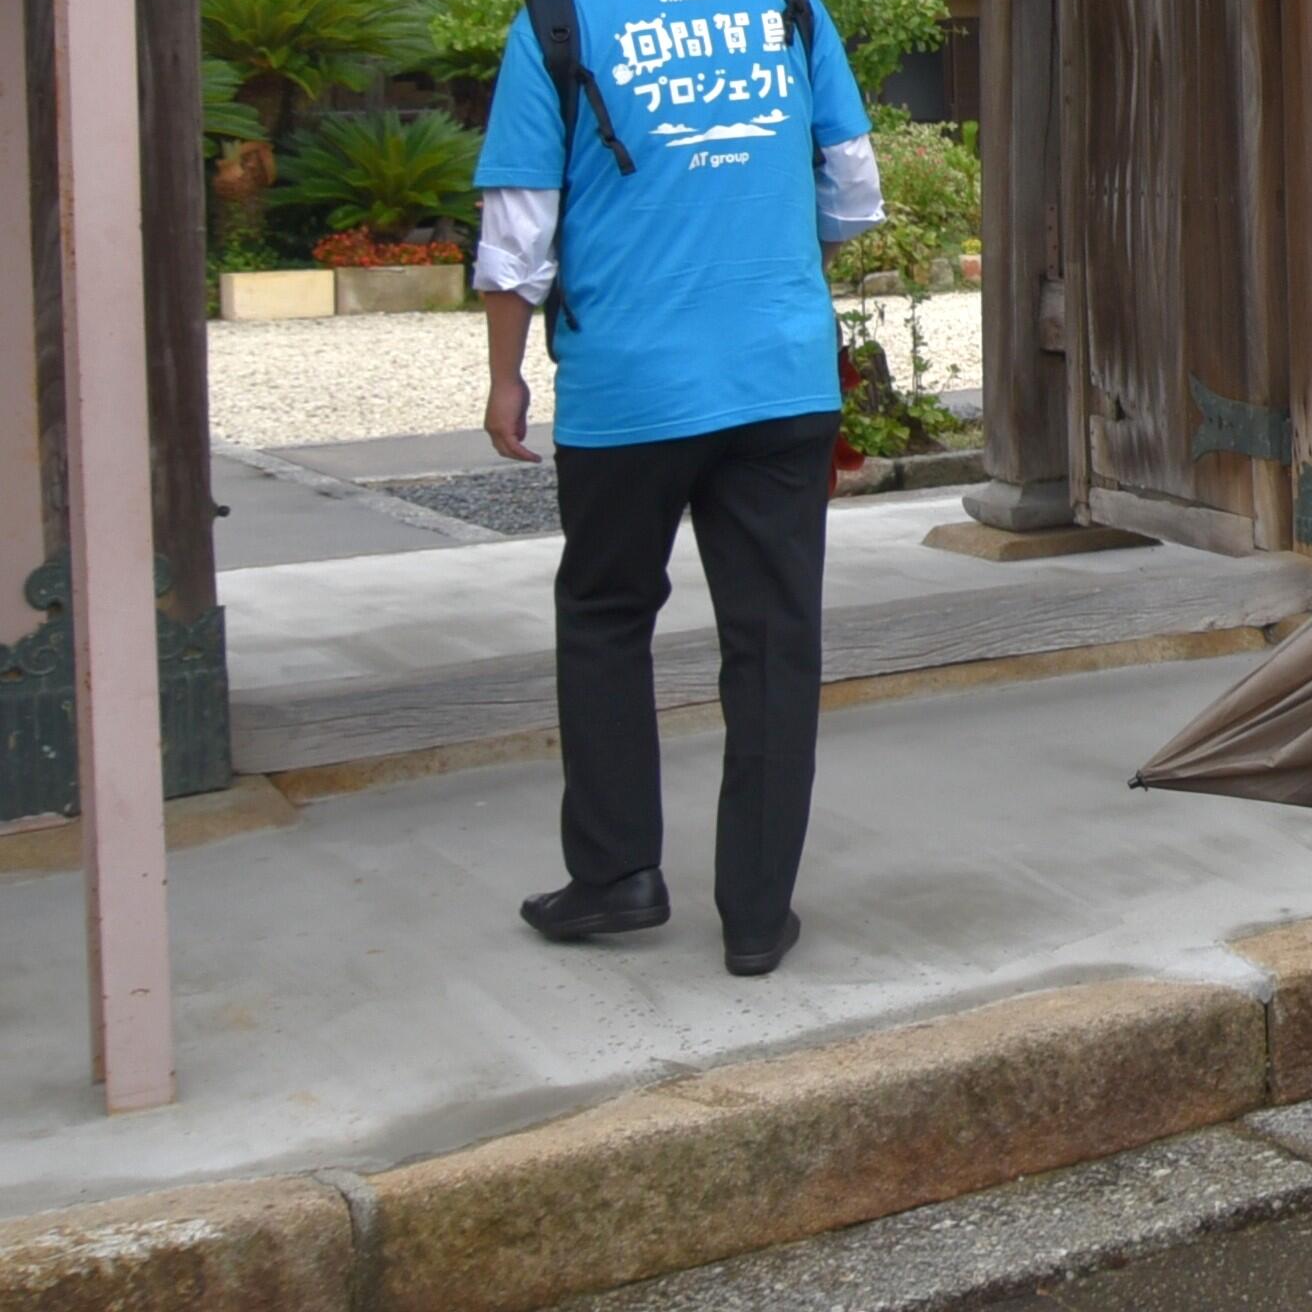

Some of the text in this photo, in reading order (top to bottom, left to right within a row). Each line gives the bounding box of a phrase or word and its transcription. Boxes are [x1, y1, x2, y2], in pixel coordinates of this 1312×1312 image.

[633, 63, 795, 113] プロジェクト
[688, 150, 750, 171] AT group
